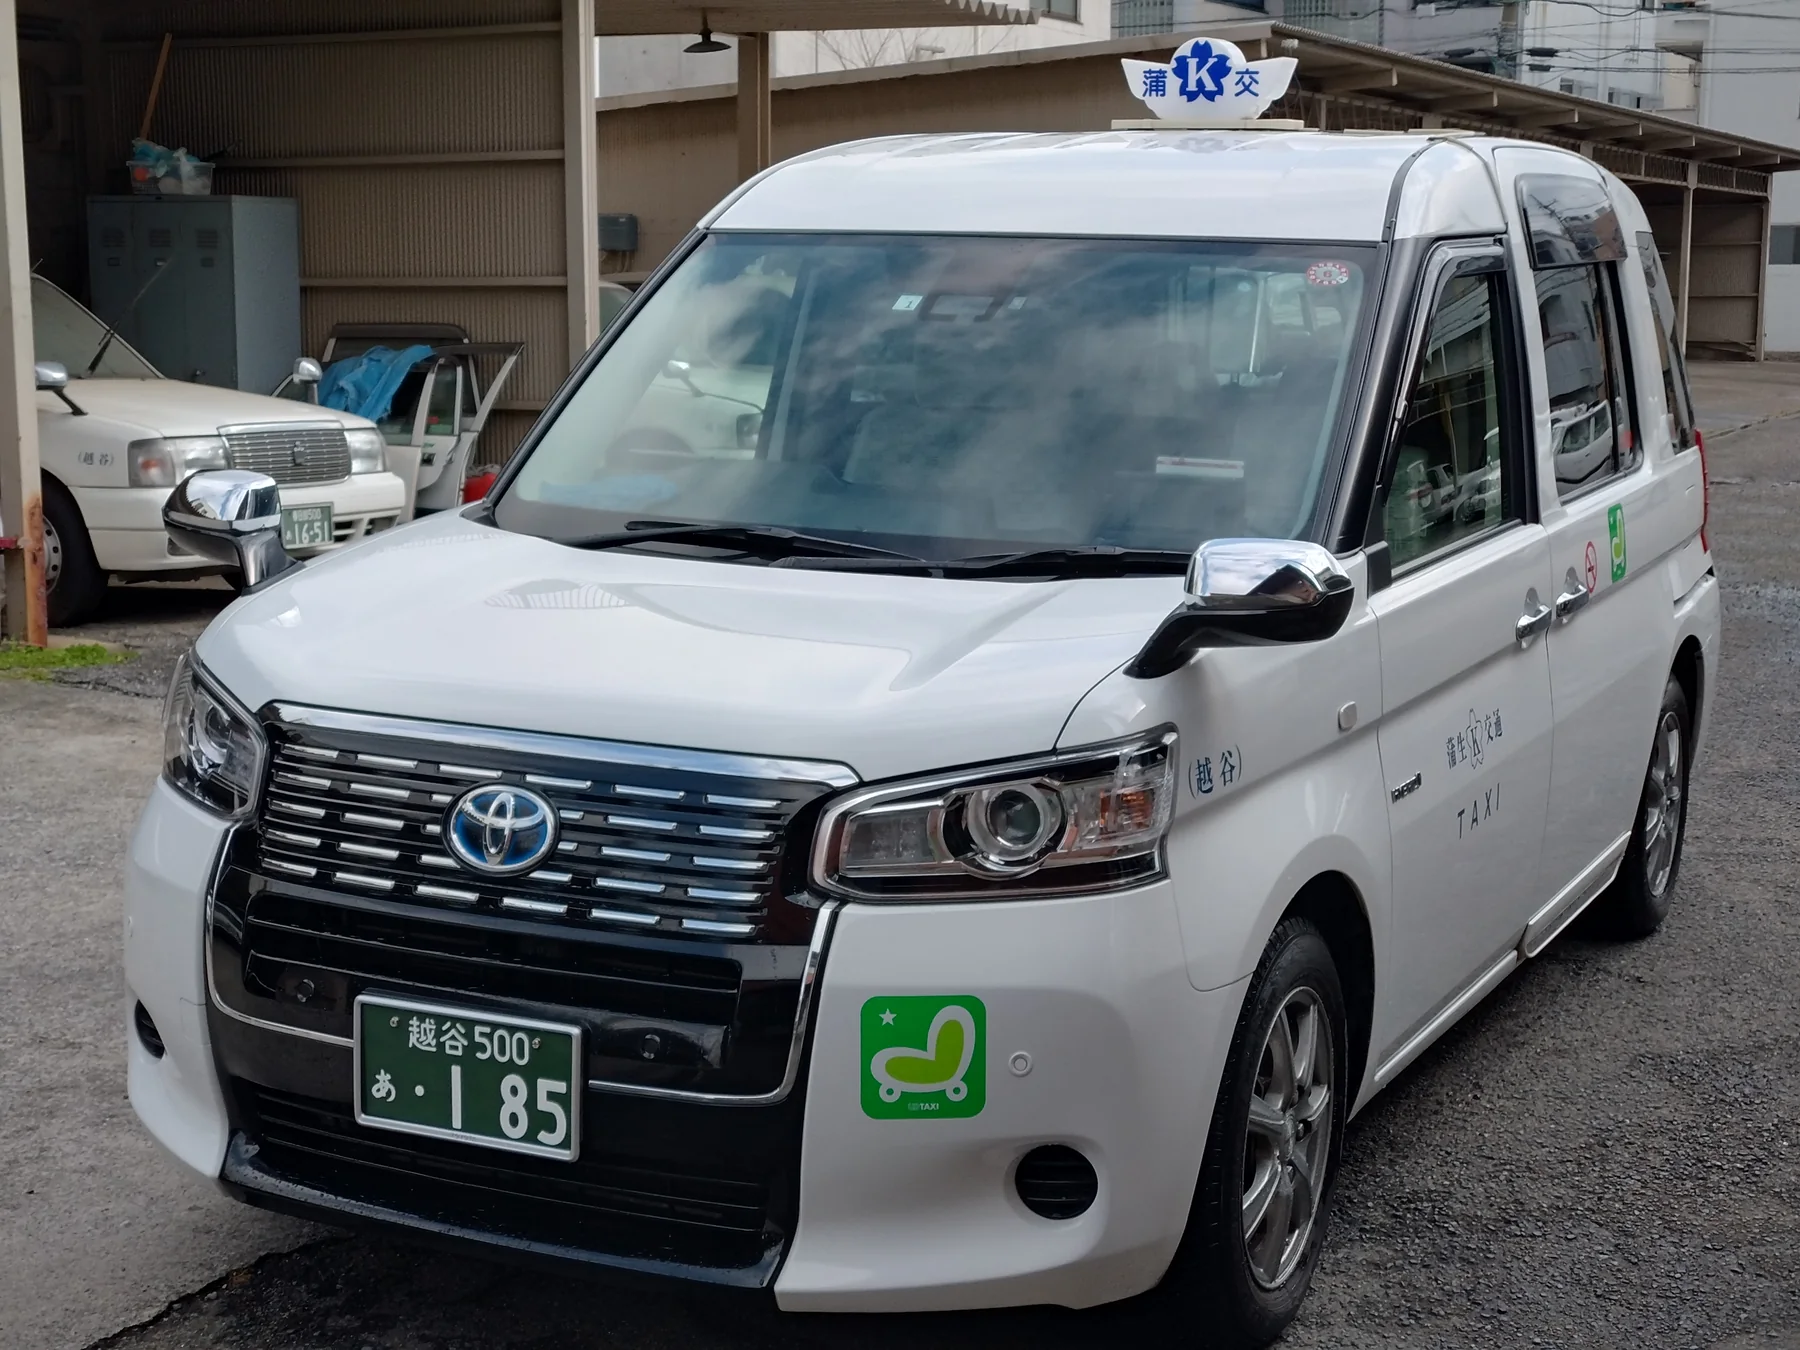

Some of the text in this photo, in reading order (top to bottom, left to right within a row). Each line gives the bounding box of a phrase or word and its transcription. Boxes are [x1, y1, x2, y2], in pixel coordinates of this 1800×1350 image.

[1186, 57, 1218, 91] K
[1234, 68, 1260, 97] 交
[1188, 743, 1241, 799] (越谷)
[1457, 782, 1500, 840] TAXI
[371, 1069, 396, 1102] あ
